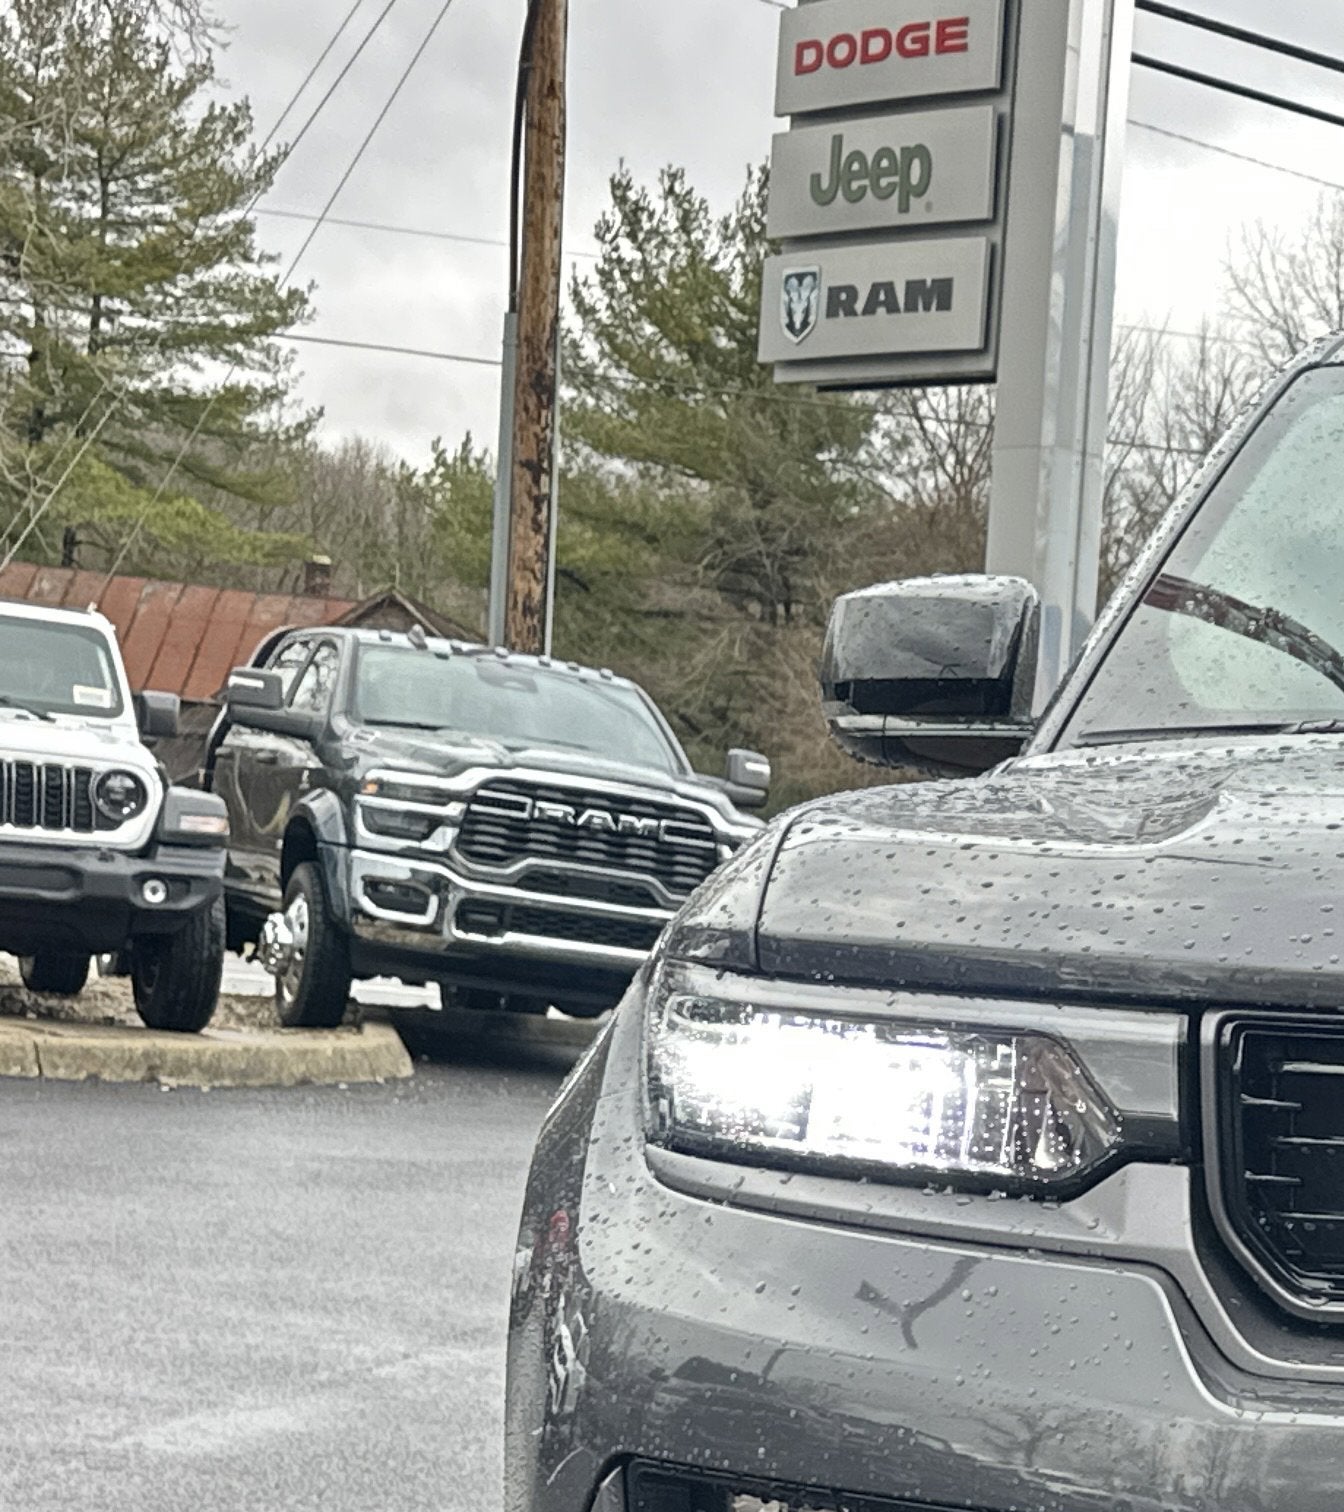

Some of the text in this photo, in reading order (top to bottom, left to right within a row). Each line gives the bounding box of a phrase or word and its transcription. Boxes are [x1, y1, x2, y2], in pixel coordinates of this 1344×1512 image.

[795, 17, 970, 76] DODGE
[810, 134, 932, 213] Jeep
[825, 277, 954, 319] RAM
[534, 800, 660, 835] RAM
